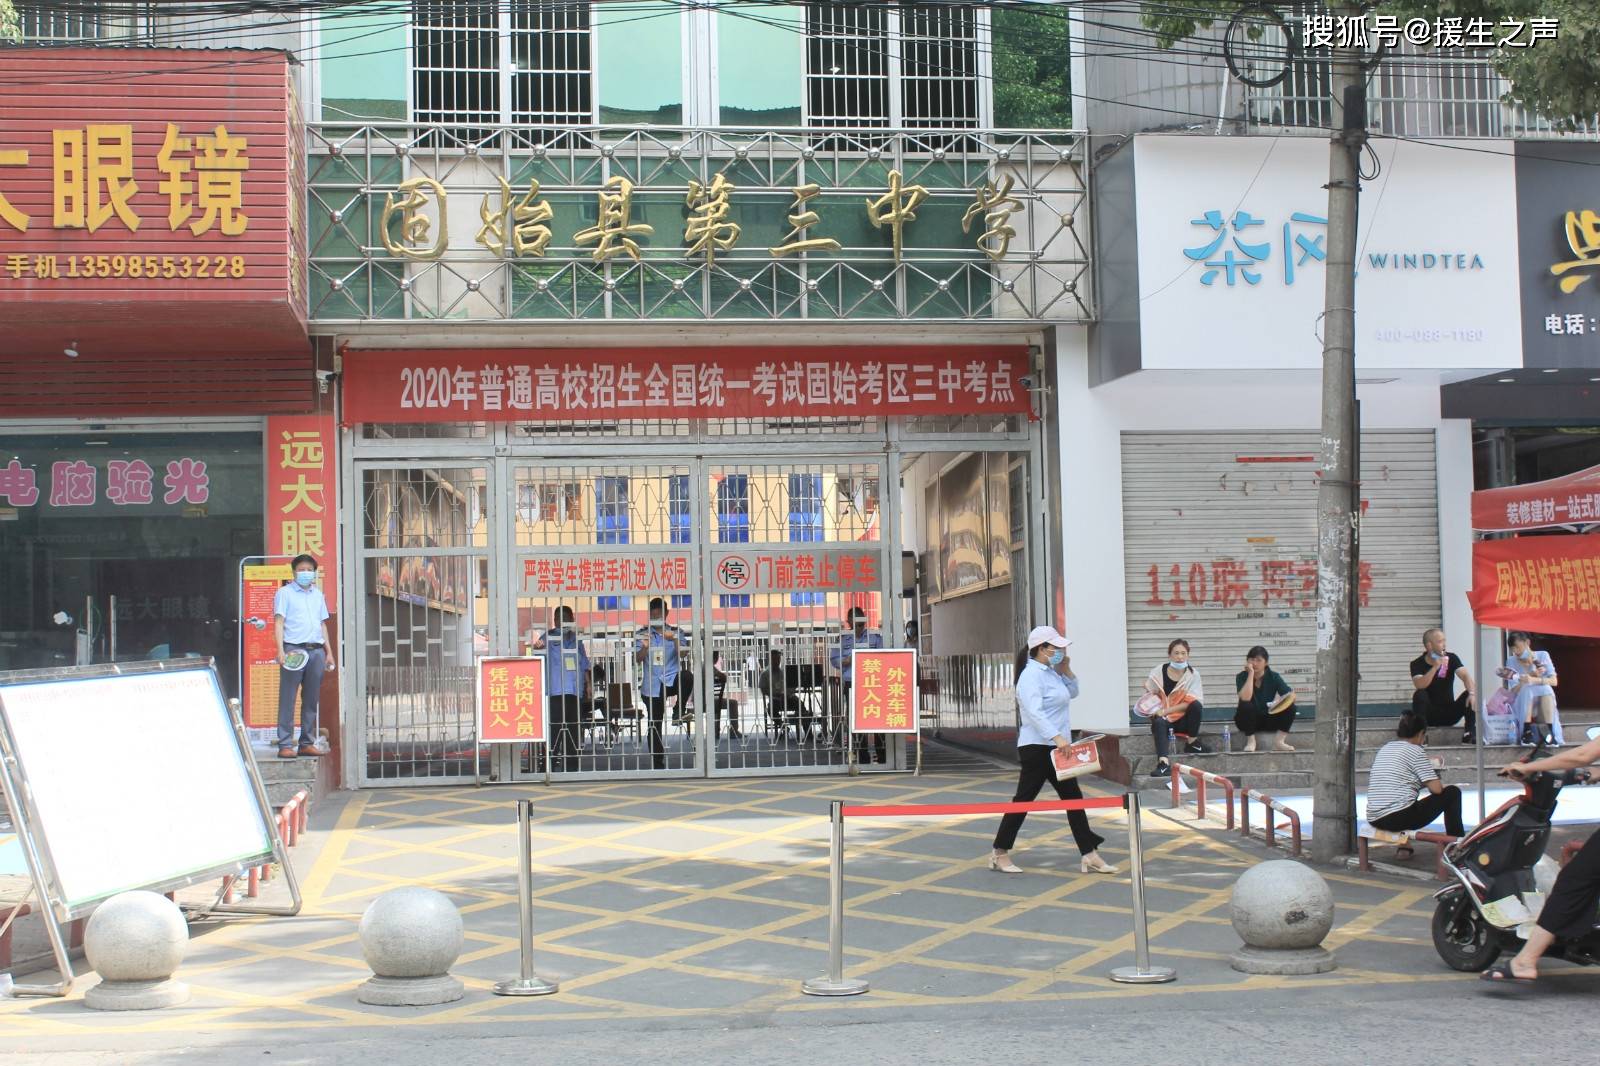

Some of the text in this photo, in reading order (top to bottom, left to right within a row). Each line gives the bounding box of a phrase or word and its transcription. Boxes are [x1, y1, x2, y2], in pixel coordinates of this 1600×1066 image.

[380, 170, 1025, 268] 固始县第三中学
[6, 255, 246, 279] 手机 13598553228
[1368, 253, 1484, 270] WINDTEA
[400, 360, 1015, 411] 2020年普通高校招生全国统一考试固始考区三中考点
[280, 430, 325, 592] 远大眼
[523, 557, 688, 593] 严禁学生携带手机进入校园
[754, 552, 878, 589] 门前禁止停车
[488, 666, 510, 728] 凭证出入
[513, 675, 535, 737] 校内人员
[862, 658, 882, 719] 禁止入内
[886, 667, 907, 727] 外来车辆
